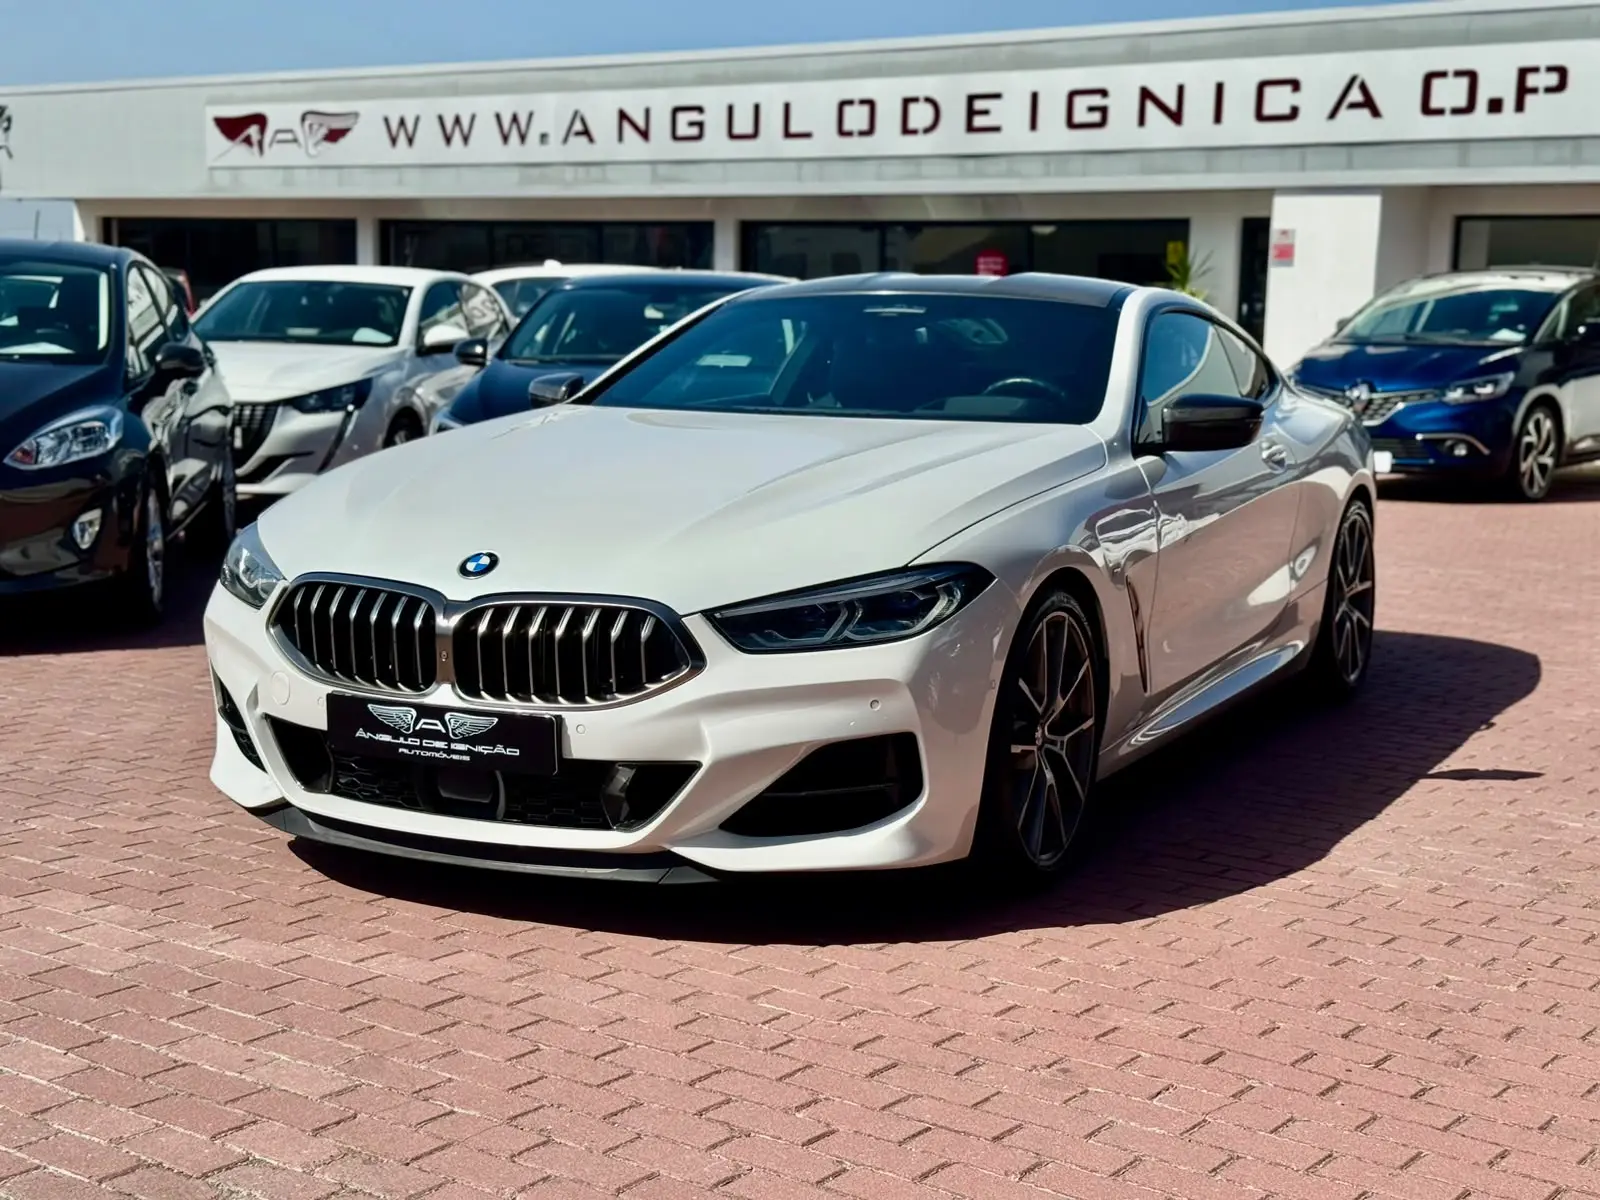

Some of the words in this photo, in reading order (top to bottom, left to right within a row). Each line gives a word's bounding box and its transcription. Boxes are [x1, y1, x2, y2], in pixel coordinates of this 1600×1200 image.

[398, 747, 471, 761] AUTOMÓVEIS
[422, 739, 448, 749] DE
[450, 742, 520, 756] IGNIÇÃO
